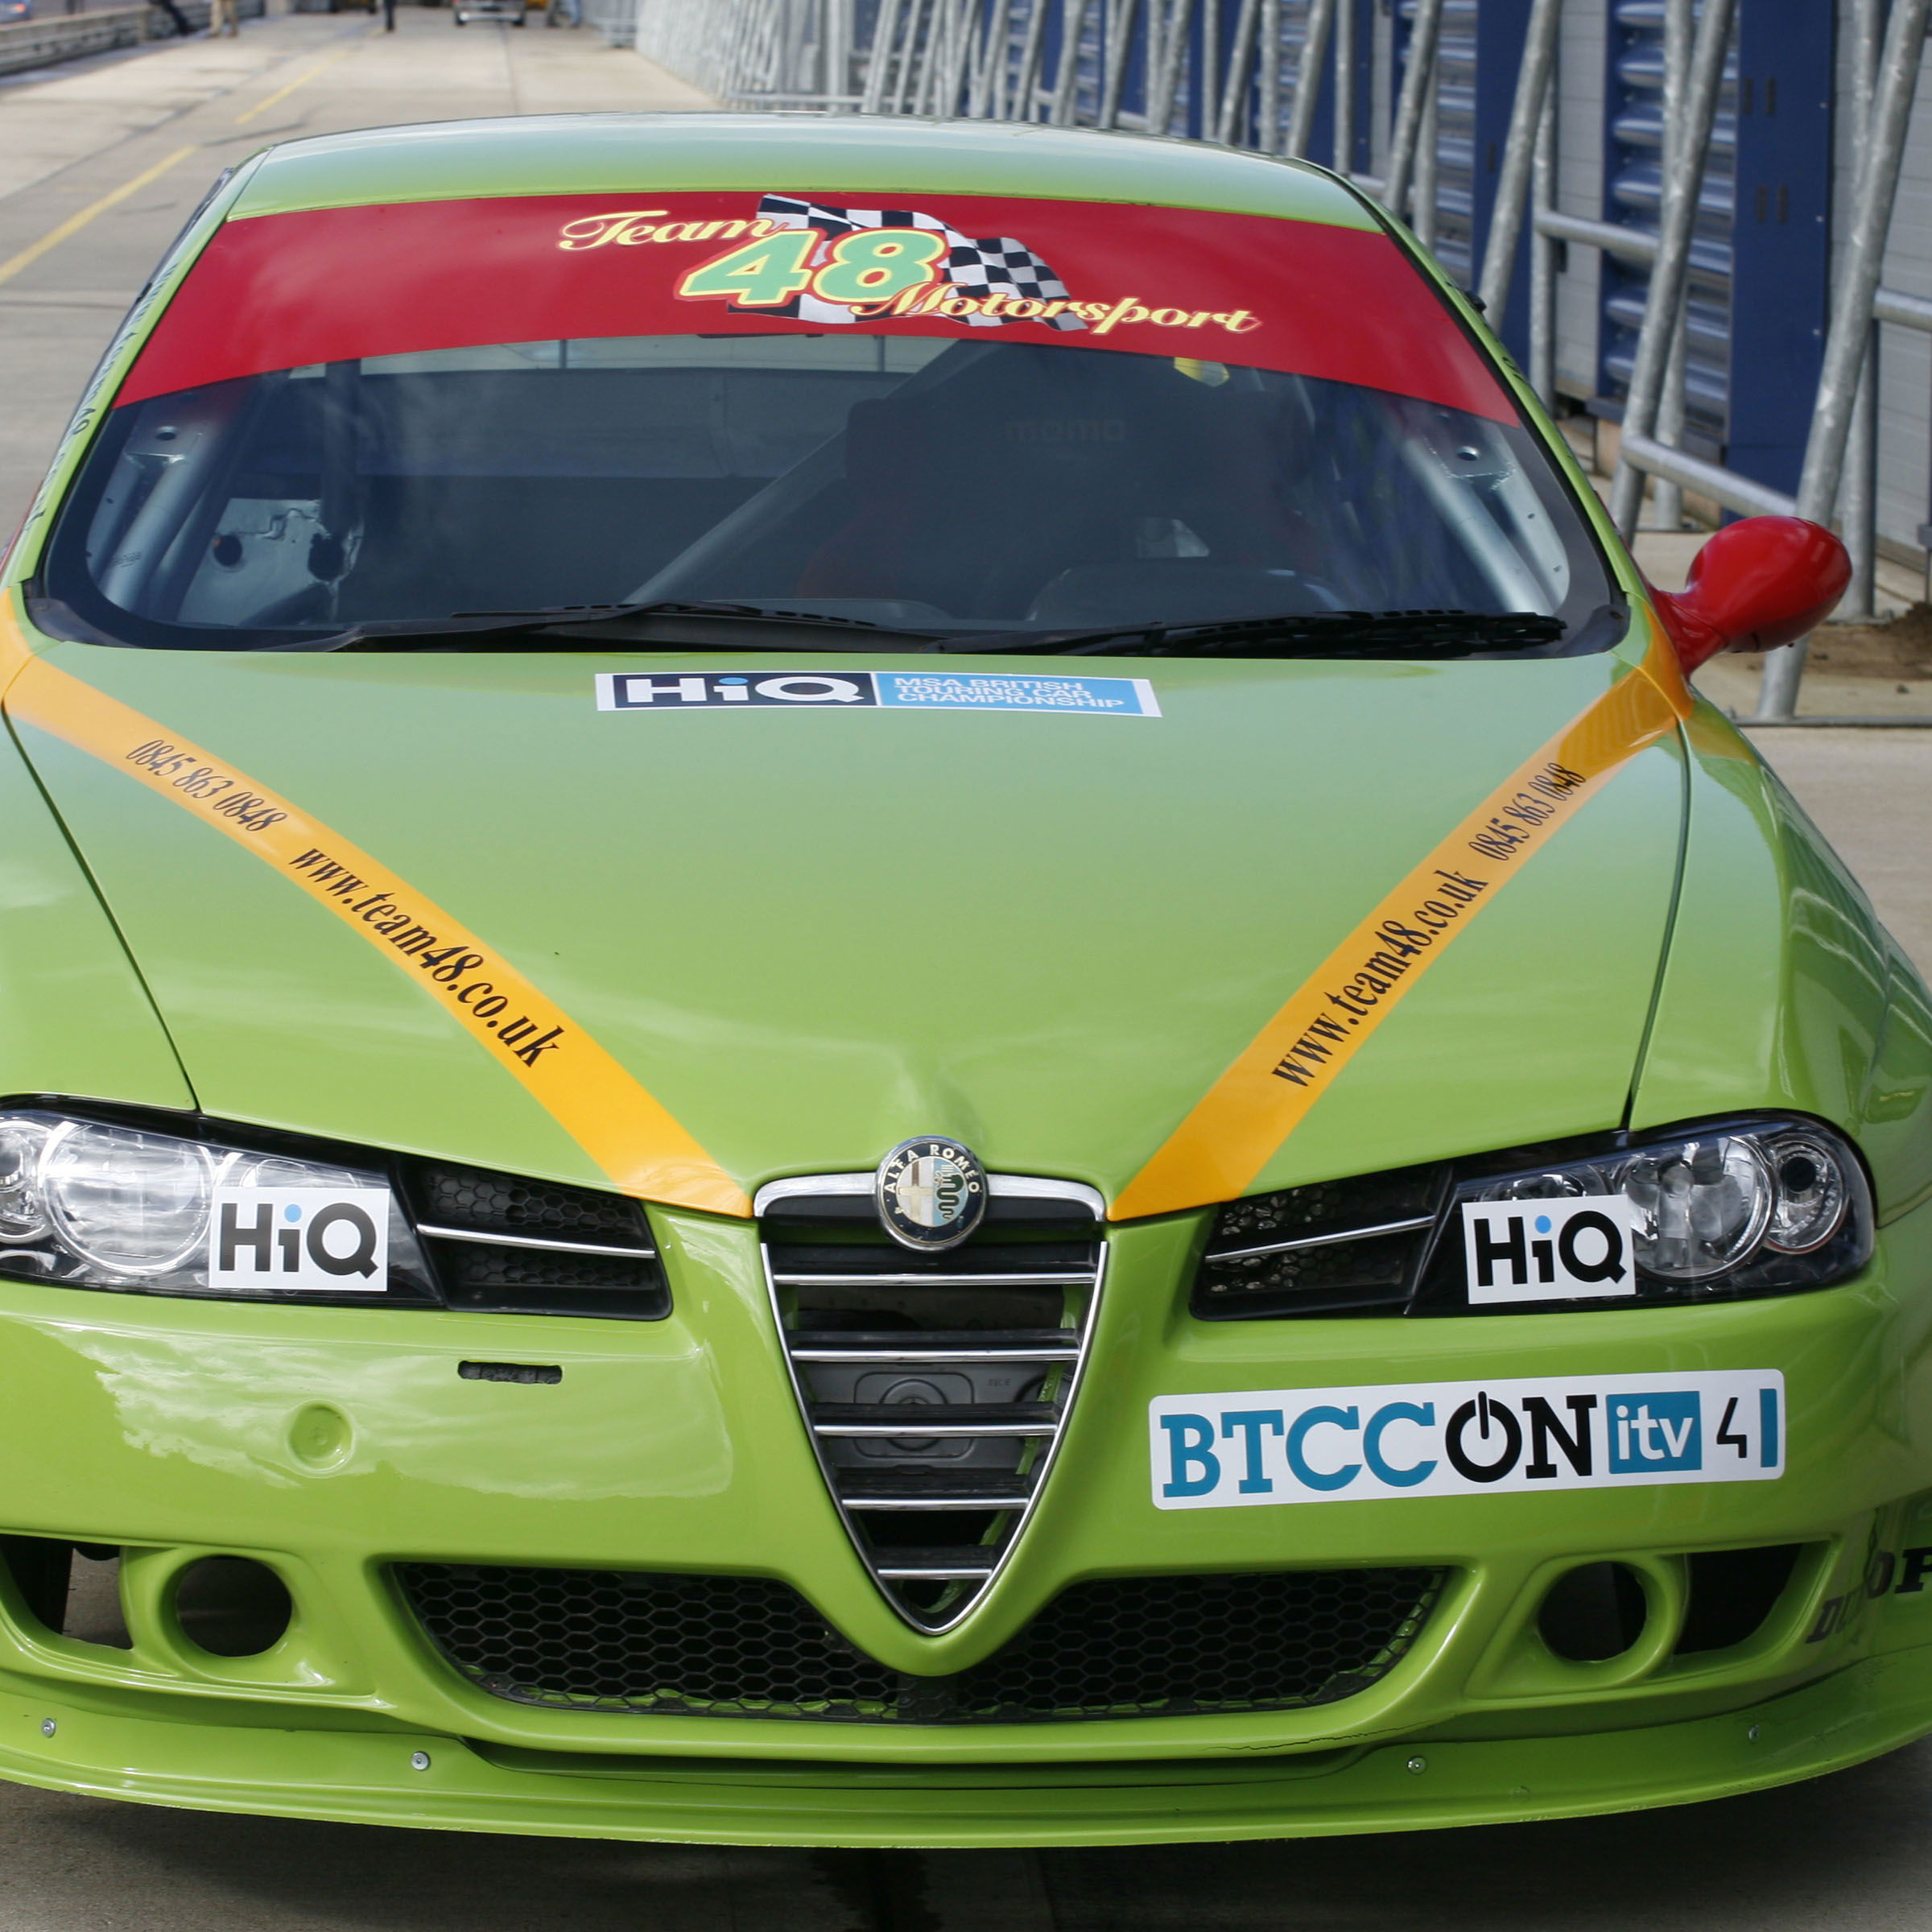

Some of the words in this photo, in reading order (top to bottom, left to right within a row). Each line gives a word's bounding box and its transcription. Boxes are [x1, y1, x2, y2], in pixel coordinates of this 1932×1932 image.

[559, 210, 781, 251] Team
[676, 228, 949, 306] 48
[850, 282, 1263, 335] Motorsport
[625, 676, 865, 703] HiQ
[894, 677, 965, 687] MSA
[968, 679, 1084, 691] BRITISH
[895, 685, 1020, 698] TOURING
[1022, 687, 1092, 700] CAR
[897, 693, 1125, 708] CHAMPIONSHIP
[1528, 762, 1587, 802] 0848
[1502, 793, 1556, 826] 863
[1468, 817, 1530, 861] 0845
[126, 739, 197, 776] 0845
[172, 767, 234, 799] 863
[213, 791, 288, 832] 0848
[288, 848, 564, 1068] www.team48.co.uk
[1271, 869, 1489, 1088] www.team48.co.uk
[884, 1150, 919, 1194] ALFA
[929, 1144, 980, 1194] ROMEO
[219, 1202, 379, 1279] HiQ
[1473, 1210, 1628, 1287] HiQ
[1616, 1404, 1694, 1461] itv
